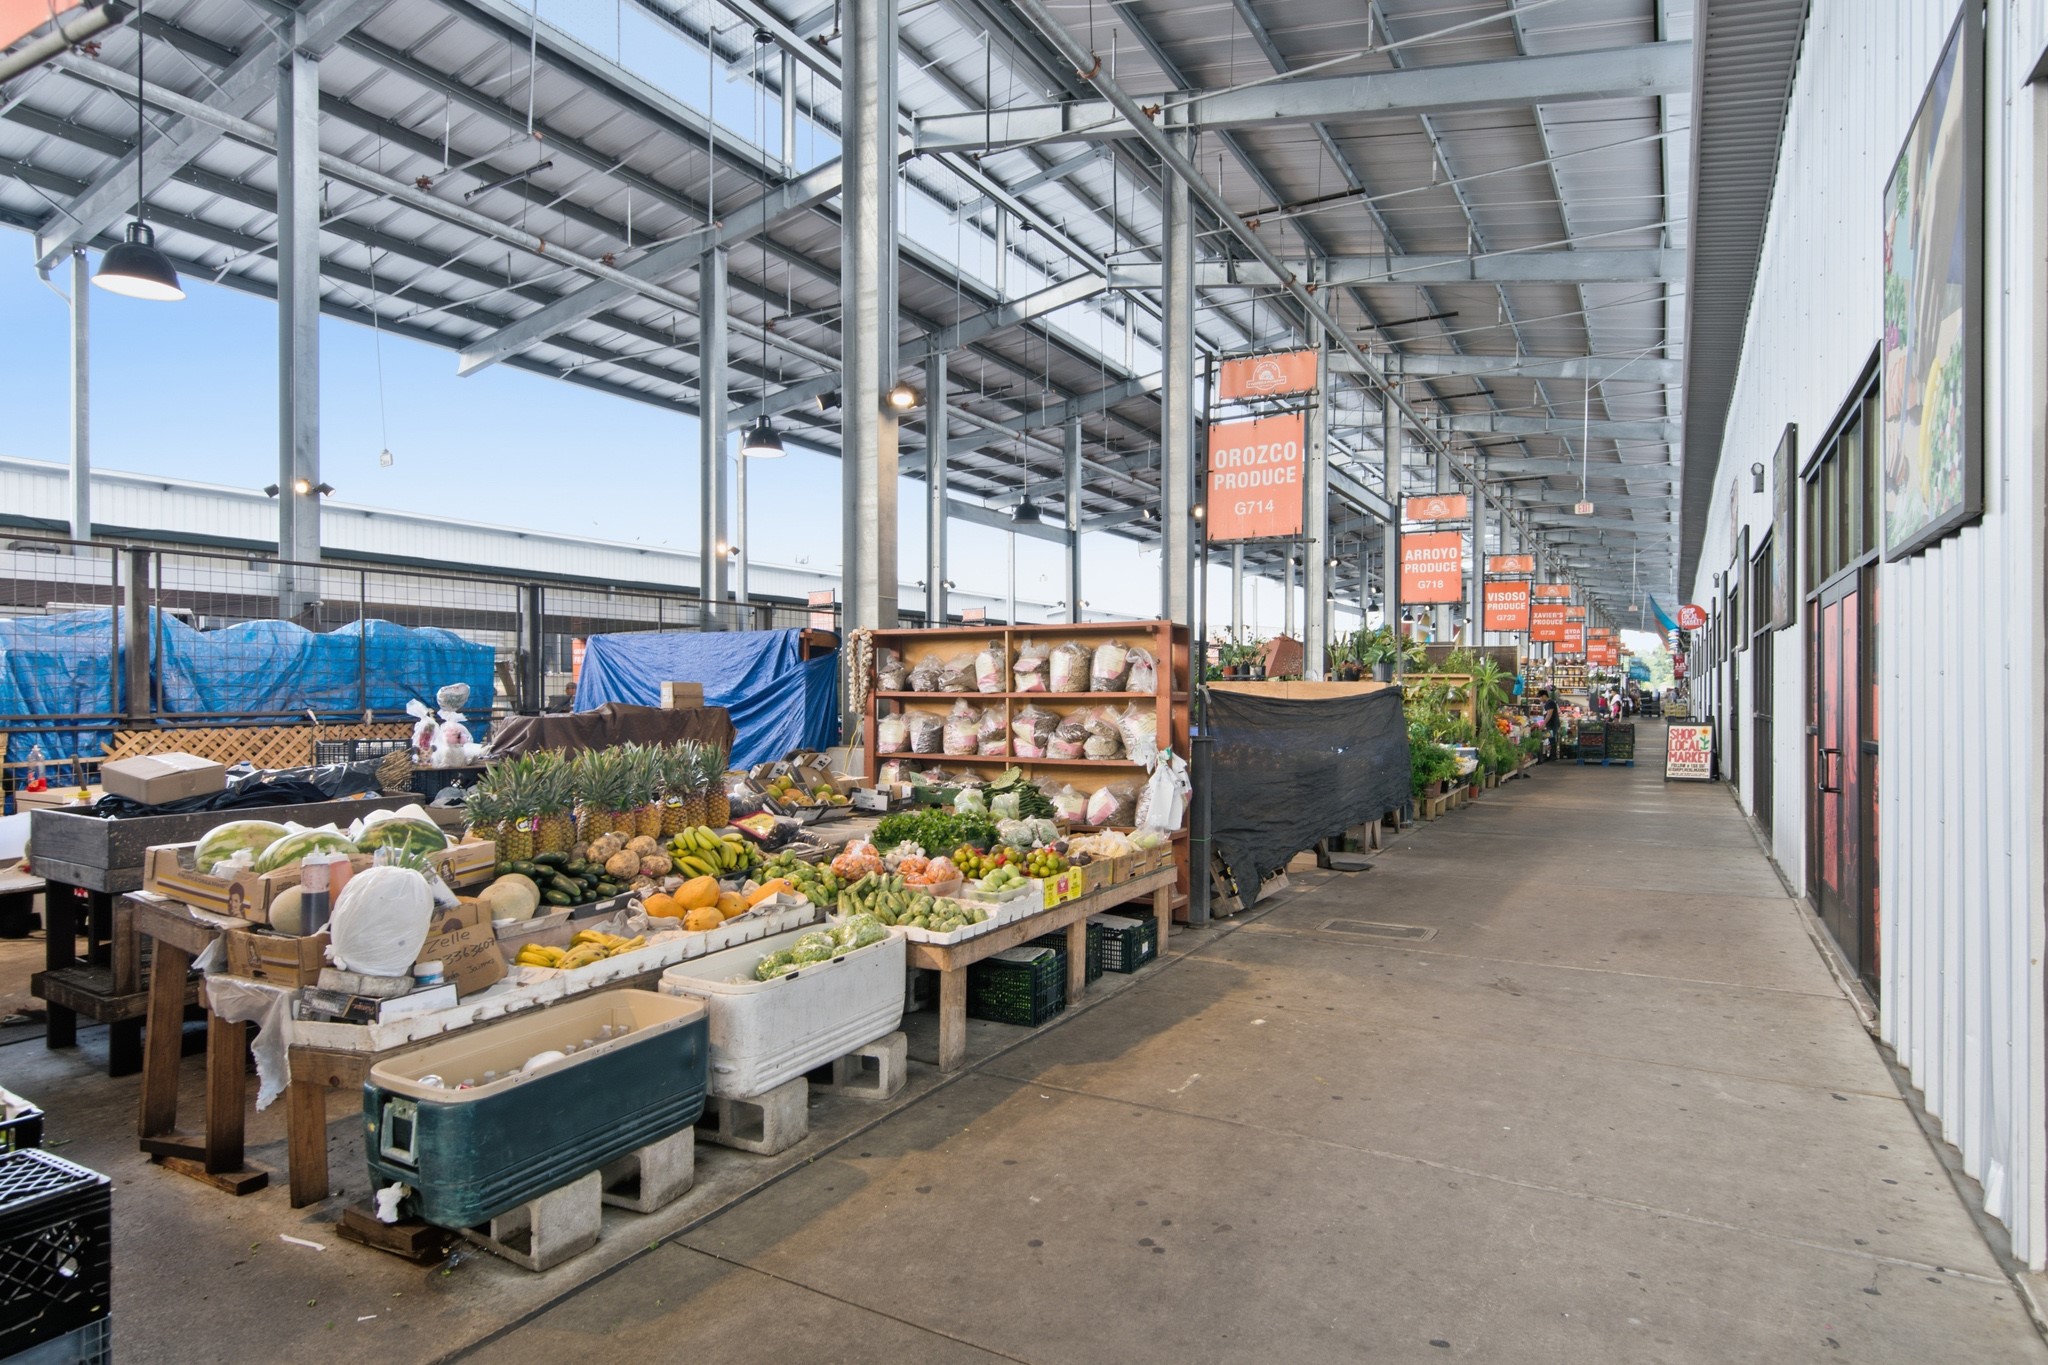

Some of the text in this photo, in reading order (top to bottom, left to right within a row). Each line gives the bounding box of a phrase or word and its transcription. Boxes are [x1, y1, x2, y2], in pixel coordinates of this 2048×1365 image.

[1214, 441, 1297, 468] OROZCO
[1214, 466, 1297, 491] PRODUCE
[1234, 499, 1274, 516] G714
[1405, 547, 1458, 560] ARROYO
[1405, 558, 1458, 573] PRODUCE
[1417, 579, 1444, 589] G718
[1487, 591, 1526, 602] VISOSO
[1487, 602, 1526, 610] PRODUCE
[1670, 728, 1697, 740] SHOP
[1669, 739, 1701, 751] LOCAL
[1669, 751, 1710, 763] MARKET
[424, 931, 470, 954] Zelle
